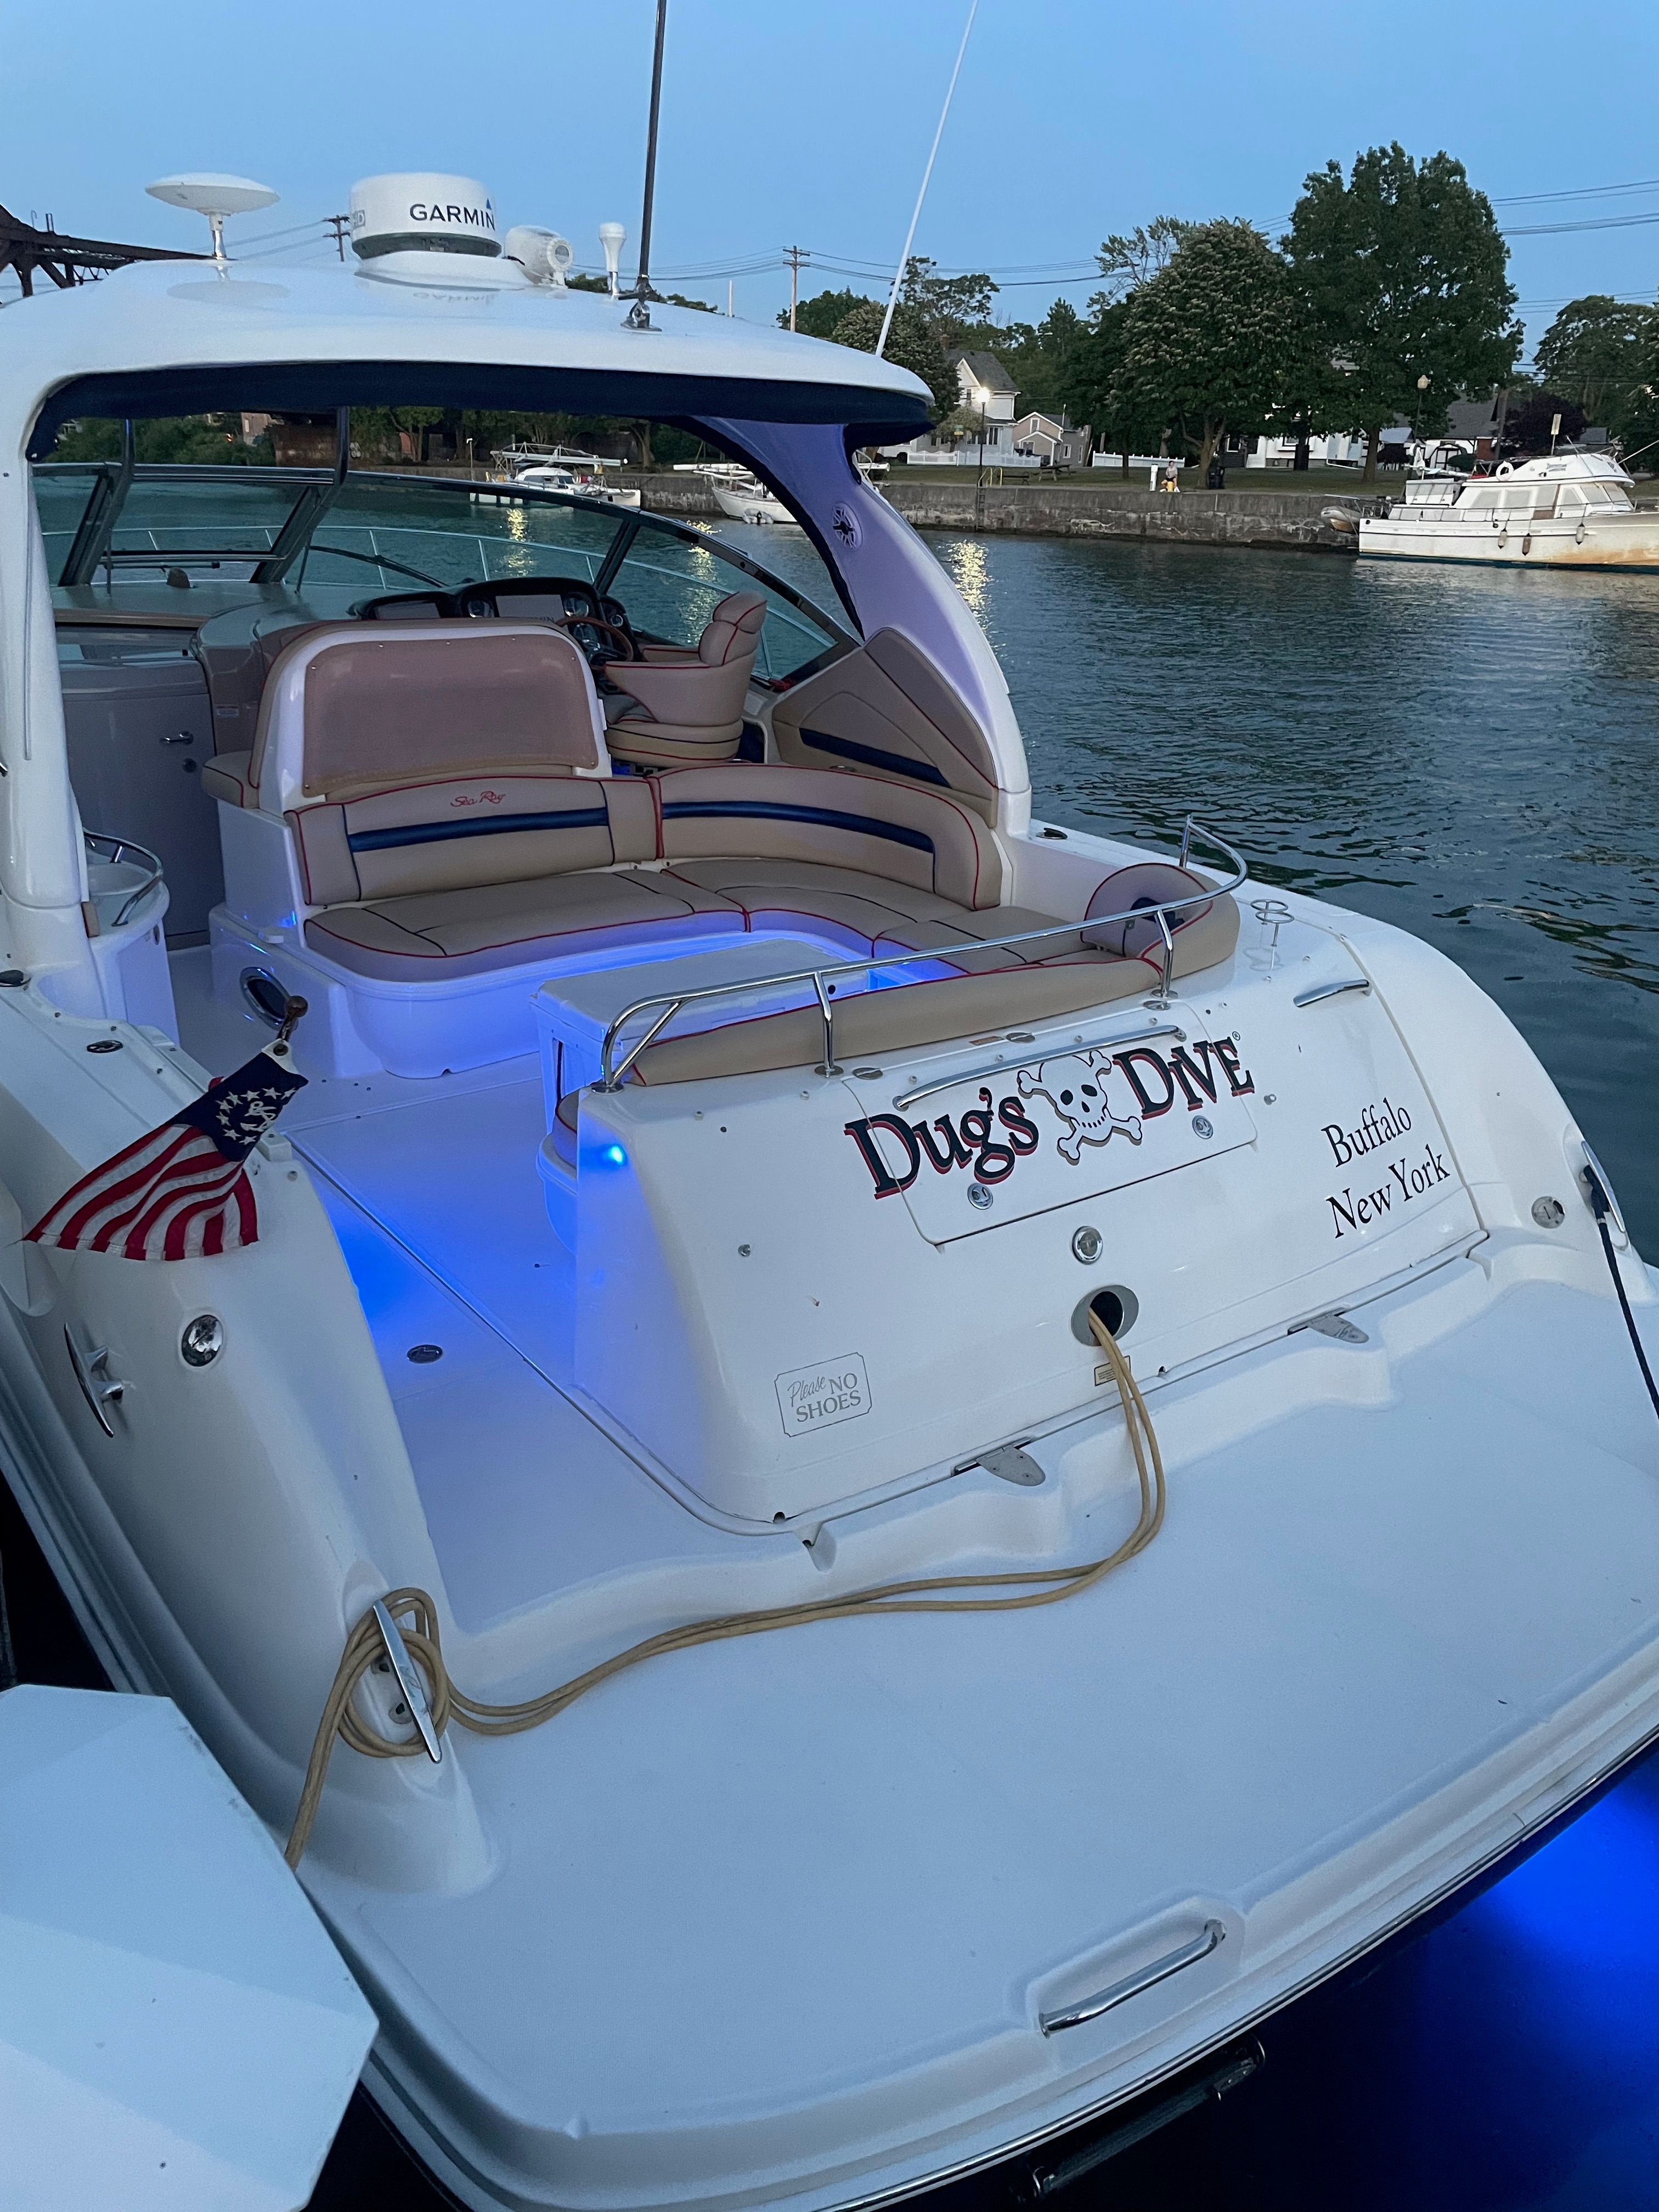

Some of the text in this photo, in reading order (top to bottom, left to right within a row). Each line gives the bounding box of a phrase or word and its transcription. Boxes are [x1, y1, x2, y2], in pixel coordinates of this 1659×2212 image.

[410, 204, 495, 231] GARMIN
[450, 796, 478, 807] Sea
[844, 1087, 1039, 1199] Dug's
[1321, 1097, 1412, 1168] Buffalo
[1325, 1143, 1451, 1239] New York
[787, 1373, 857, 1407] Please NO
[796, 1390, 861, 1422] SHOES
